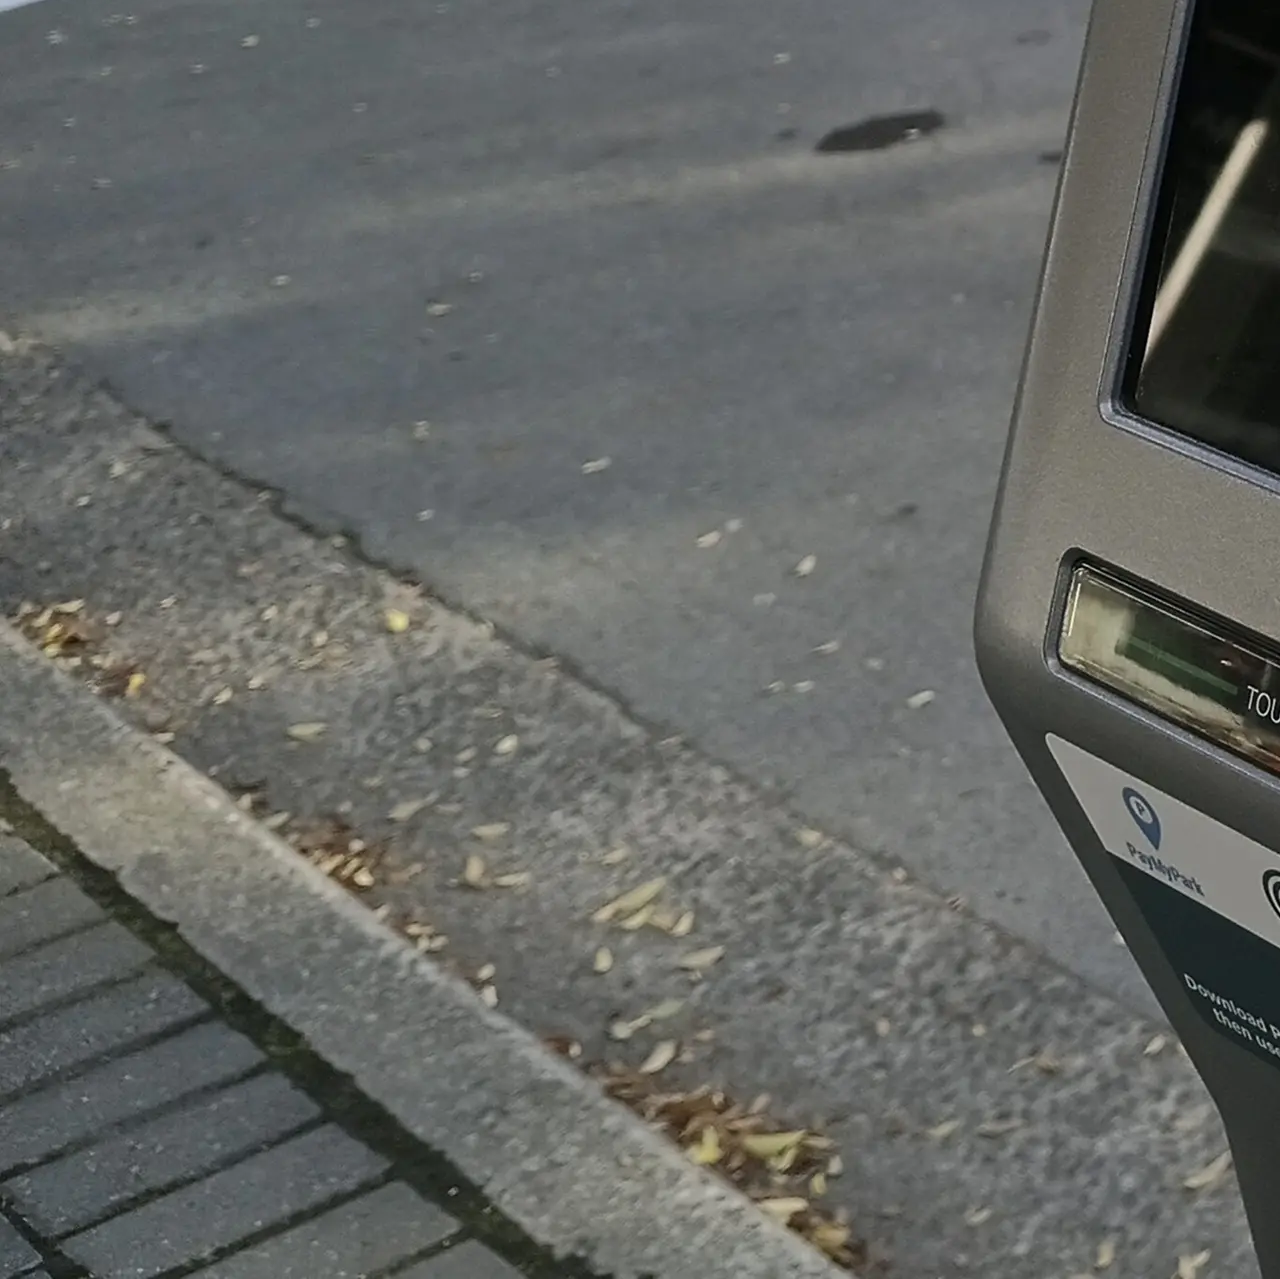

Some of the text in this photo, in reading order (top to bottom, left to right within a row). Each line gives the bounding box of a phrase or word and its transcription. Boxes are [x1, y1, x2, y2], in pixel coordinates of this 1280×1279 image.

[1126, 841, 1205, 897] PayMyPark
[1184, 973, 1267, 1032] Download
[1213, 1008, 1252, 1041] then
